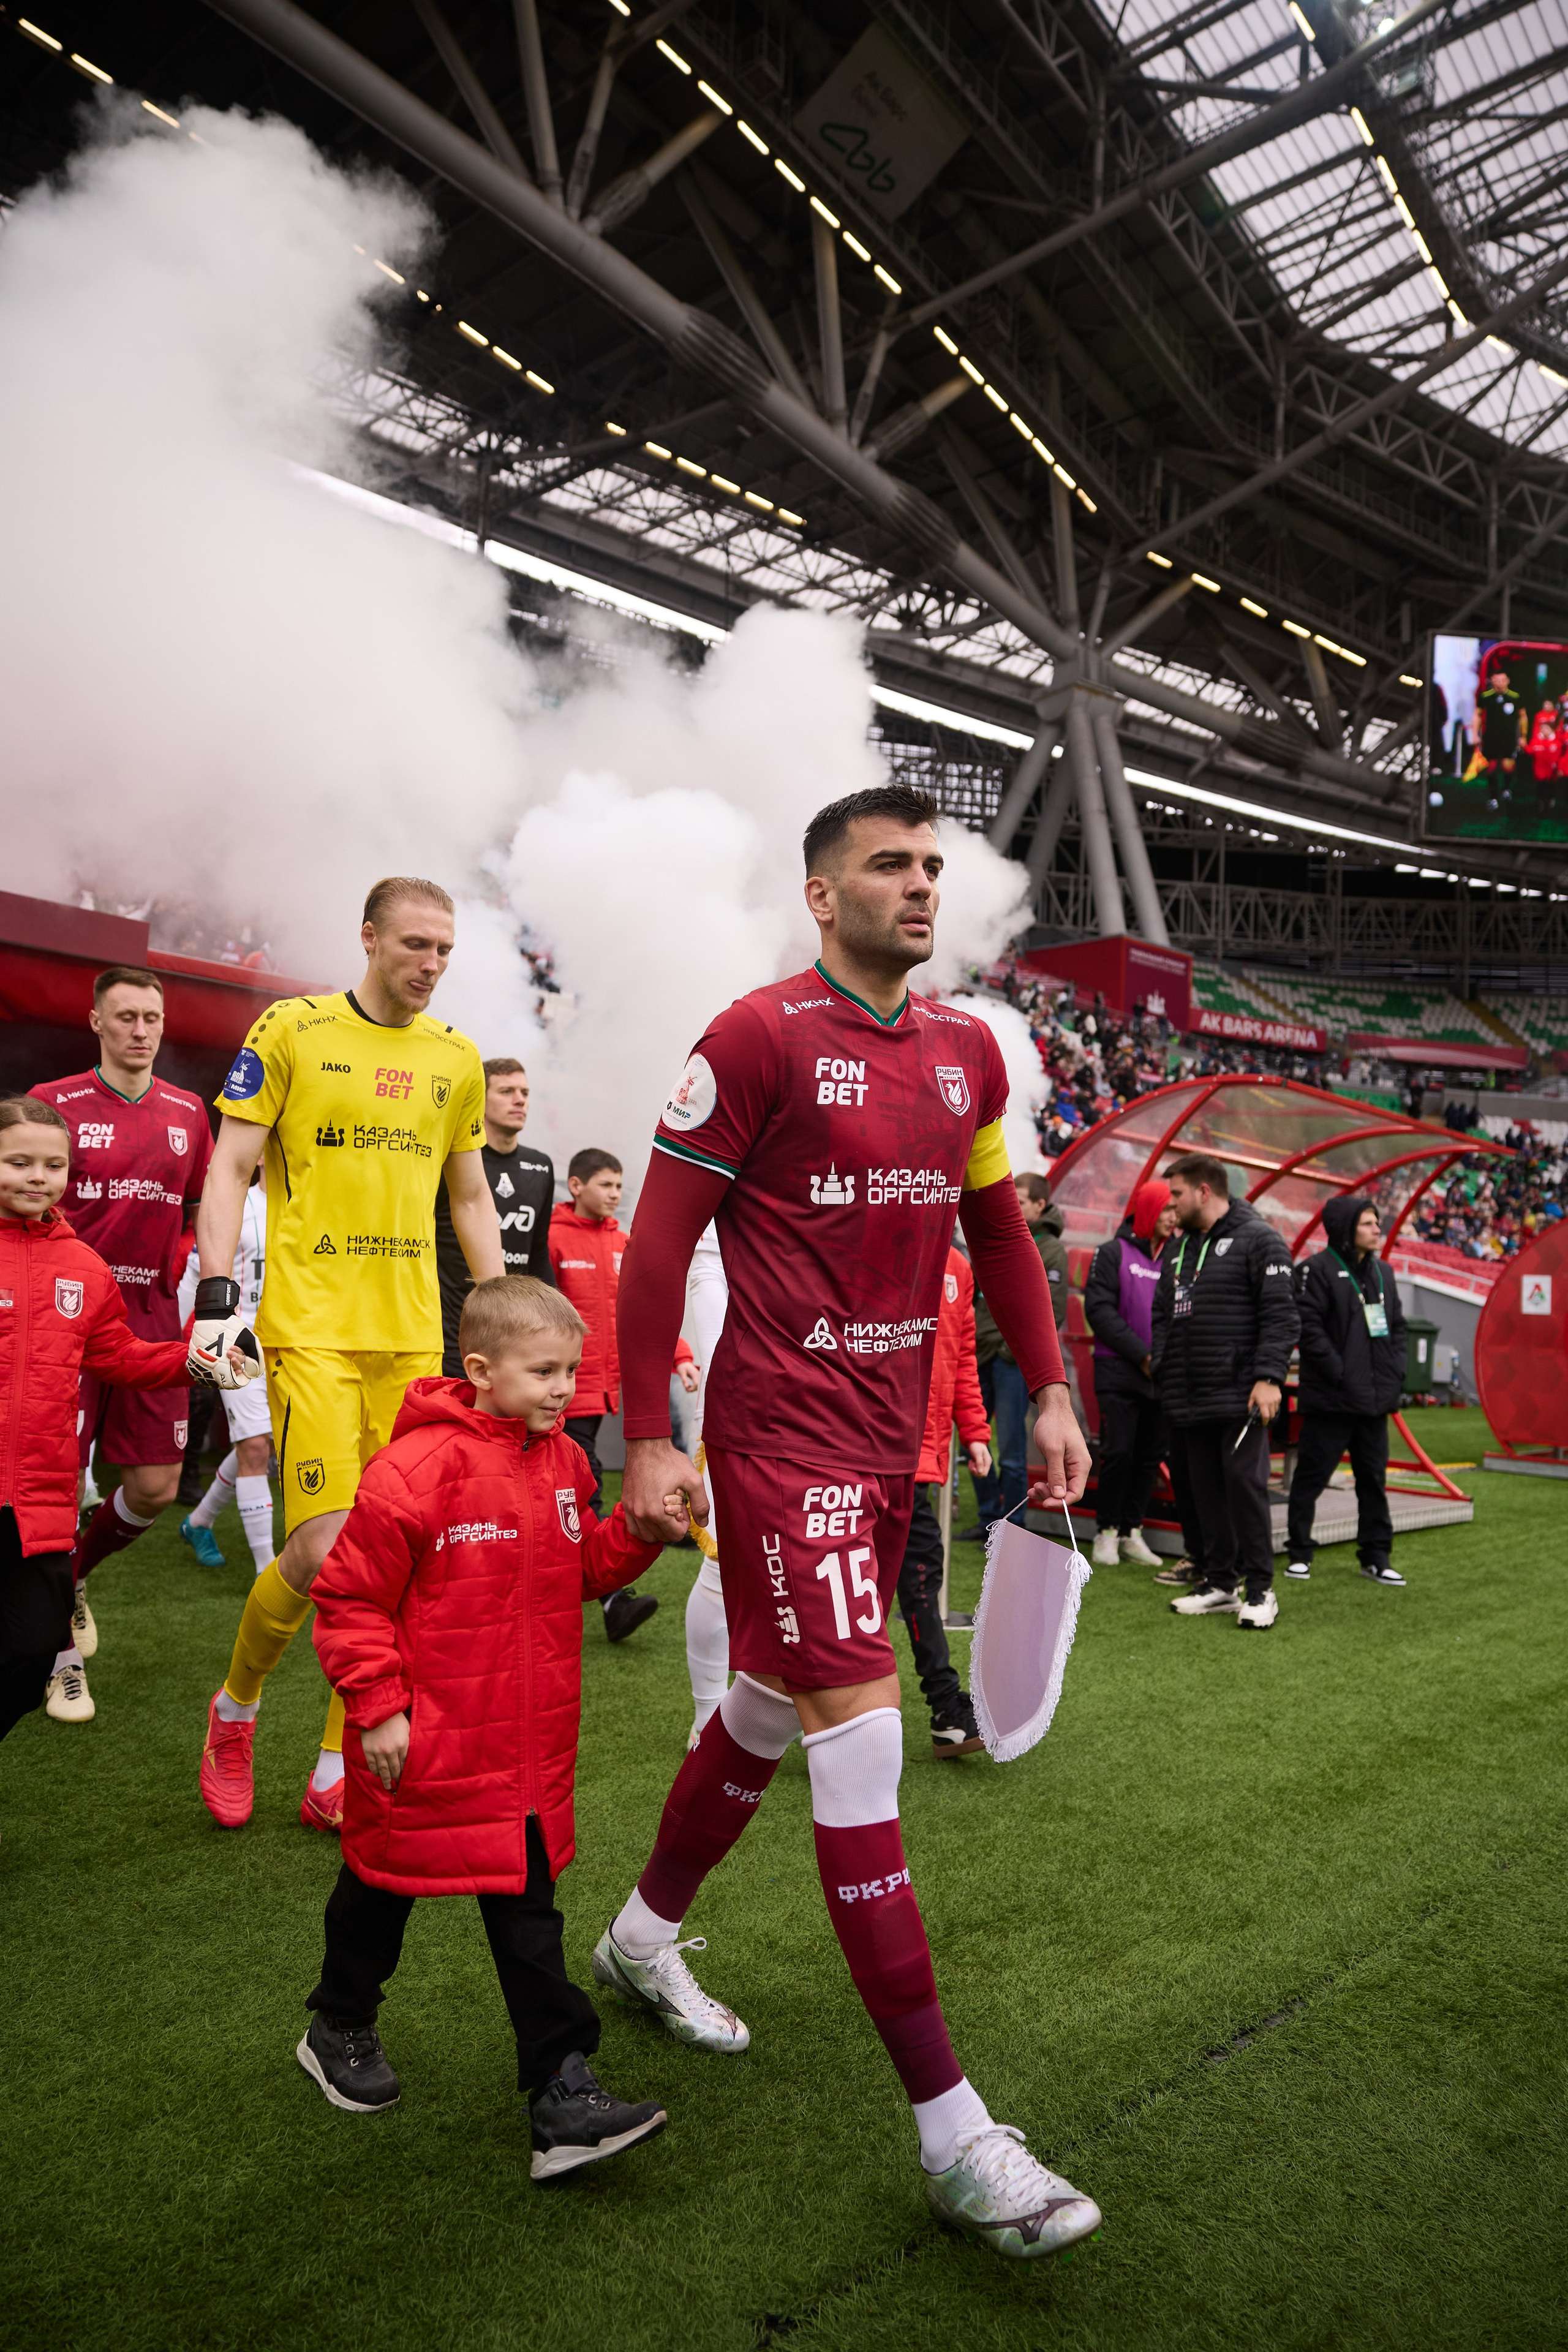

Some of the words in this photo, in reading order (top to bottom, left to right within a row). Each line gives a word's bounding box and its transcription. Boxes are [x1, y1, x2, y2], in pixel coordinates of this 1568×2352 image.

[796, 997, 835, 1011] НКНХ
[308, 1015, 338, 1027] НКНХ
[1199, 1012, 1221, 1032] AK
[1223, 1015, 1263, 1040] BARS
[1264, 1023, 1317, 1048] ARENA
[423, 1027, 466, 1051] ИНГОССТРАХ
[321, 1061, 351, 1073] JAKO
[815, 1057, 866, 1082] FON
[375, 1068, 413, 1084] FON
[375, 1082, 414, 1100] BET
[816, 1081, 869, 1106] BET
[78, 1123, 114, 1136] FON
[354, 1125, 417, 1141] КАЗАНЬ
[78, 1135, 115, 1148] BET
[353, 1137, 432, 1158] ОРГСИНТЕЗ
[109, 1178, 164, 1191] КАЗАНЬ
[868, 1168, 947, 1186] КАЗАНЬ
[108, 1188, 183, 1205] ОРГСИНТЕЗ
[868, 1186, 962, 1204] ОРГСИНТЕЗ
[57, 1280, 81, 1289] РУБИН
[845, 1333, 922, 1354] НЕФТЕХИМ
[296, 1458, 322, 1468] РУБИН
[557, 1490, 575, 1499] РУБ
[802, 1484, 863, 1512] FON
[448, 1522, 497, 1535] КАЗАНЬ
[805, 1509, 864, 1538] BET
[450, 1529, 517, 1544] ОРГСИНТЕЗ
[815, 1547, 881, 1640] 15
